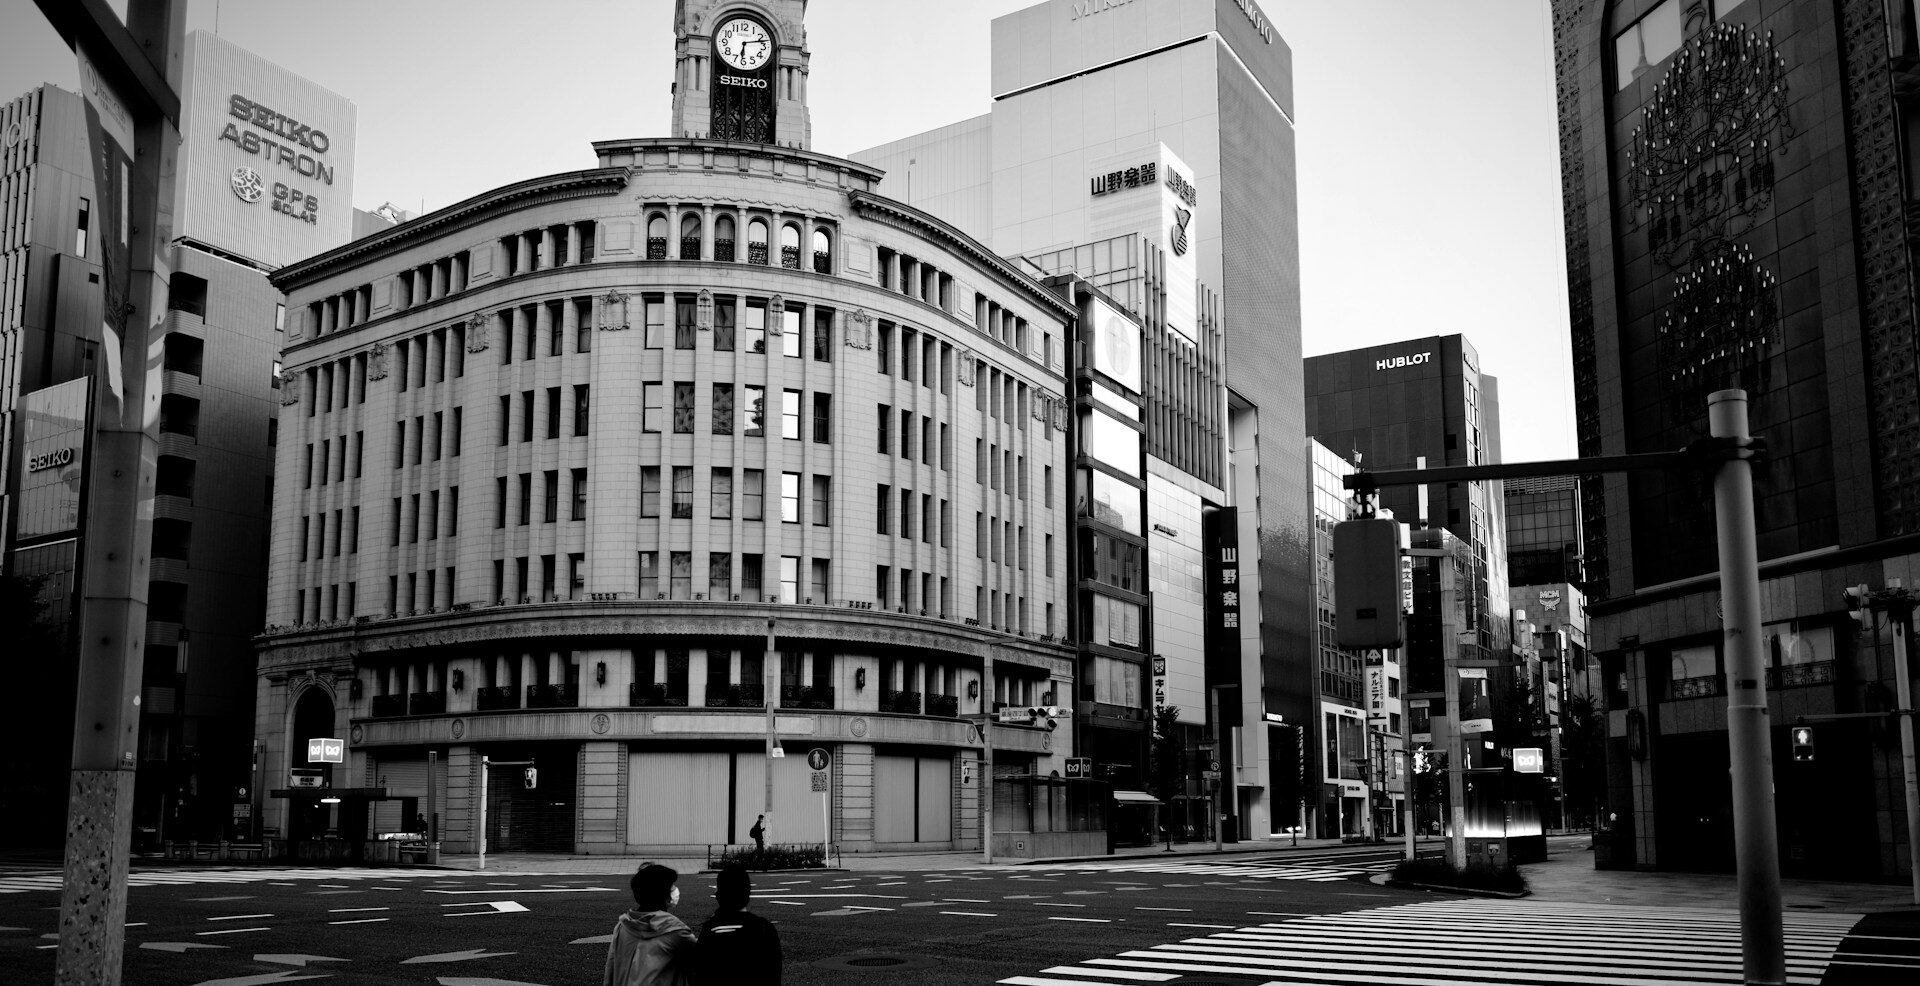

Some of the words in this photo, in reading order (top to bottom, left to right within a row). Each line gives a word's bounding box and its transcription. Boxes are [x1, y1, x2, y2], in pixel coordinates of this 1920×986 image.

[725, 30, 732, 38] 10
[733, 24, 738, 32] 11
[741, 23, 749, 31] 12
[720, 75, 768, 89] SEIKO
[230, 94, 330, 154] SEIKO
[219, 123, 333, 186] ASTRON
[1091, 162, 1156, 196] 山野楽器
[273, 182, 318, 213] GPS
[272, 200, 317, 225] SOLAR
[1376, 352, 1432, 371] HUBLOT
[29, 448, 72, 472] SEIKO
[1222, 547, 1238, 628] 山野楽器
[1371, 671, 1380, 709] ナルニア国
